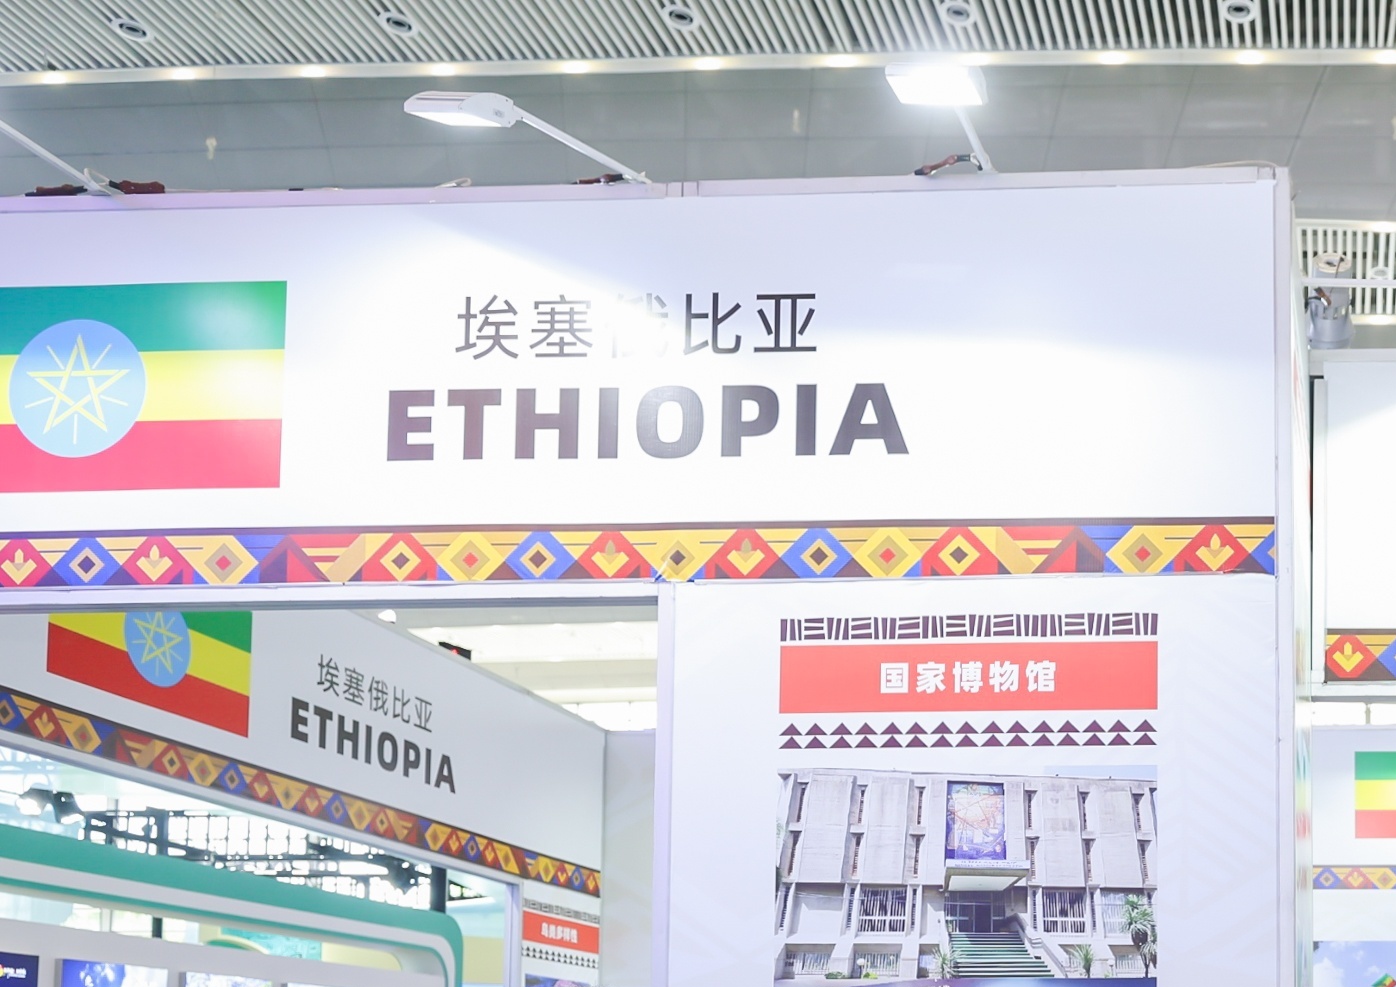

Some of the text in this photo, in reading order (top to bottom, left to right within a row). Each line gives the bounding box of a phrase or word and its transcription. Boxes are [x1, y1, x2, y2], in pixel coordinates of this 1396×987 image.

[386, 382, 909, 461] ETHIOPIA
[317, 653, 432, 733] 埃塞俄比亚
[880, 660, 1056, 694] 国家博物馆
[290, 696, 456, 794] ETHIOPIA
